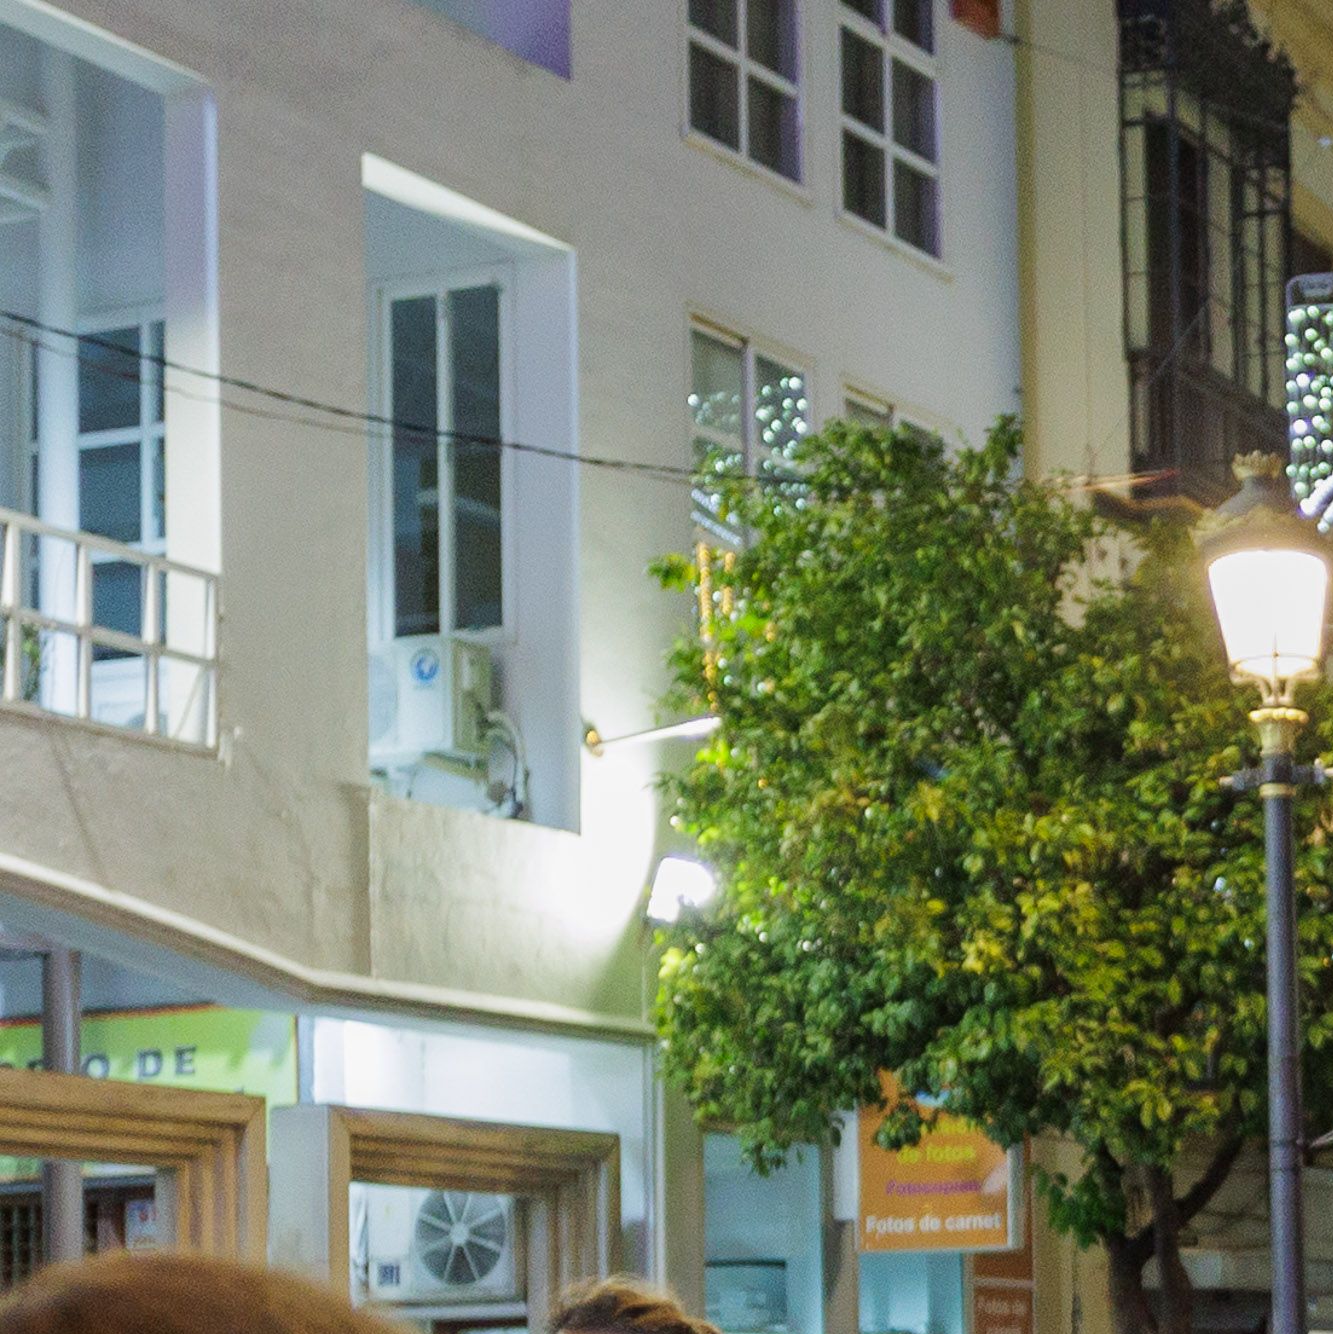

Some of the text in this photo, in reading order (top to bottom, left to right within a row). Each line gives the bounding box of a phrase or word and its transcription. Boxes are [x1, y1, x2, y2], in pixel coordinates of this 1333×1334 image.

[137, 1046, 197, 1079] DE
[865, 1212, 1002, 1233] Fotos de carnet
